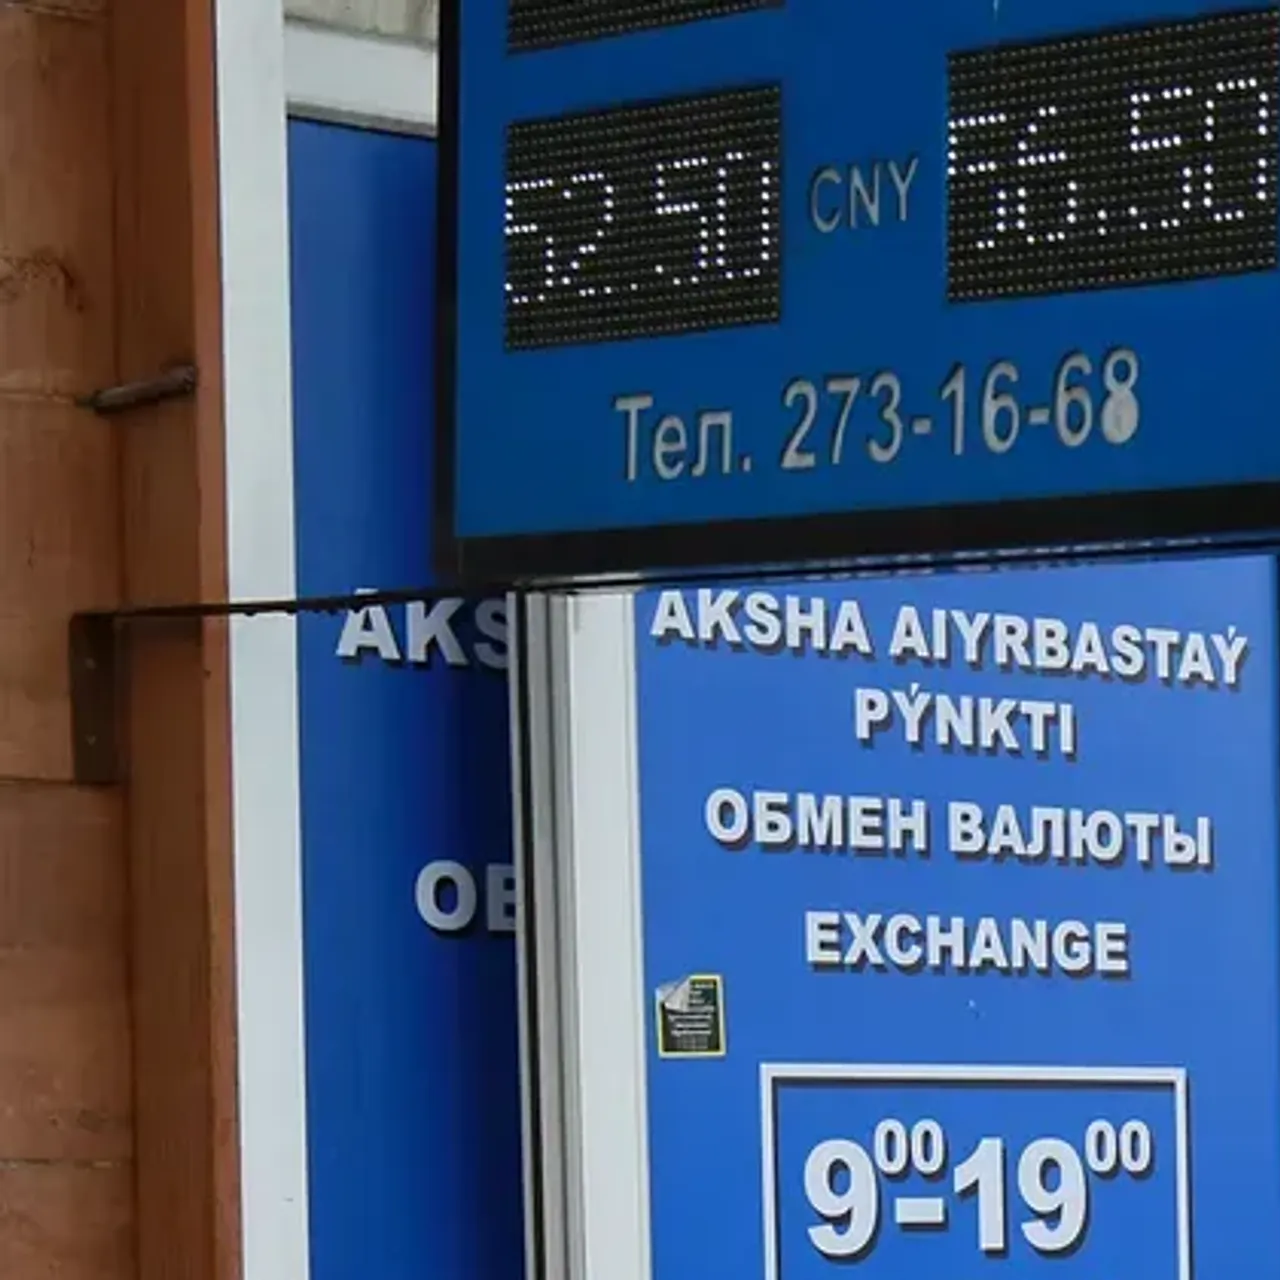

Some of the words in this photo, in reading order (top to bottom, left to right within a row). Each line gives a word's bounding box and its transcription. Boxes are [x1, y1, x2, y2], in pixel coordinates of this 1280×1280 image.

[810, 158, 920, 234] CNY
[614, 394, 751, 481] Тел.
[780, 348, 1140, 471] 273-16-68
[650, 588, 872, 654] AKSHA
[704, 789, 929, 853] ОБМЕН
[947, 803, 1213, 866] ВАЛЮТЫ
[805, 911, 1129, 973] EXCHANGE
